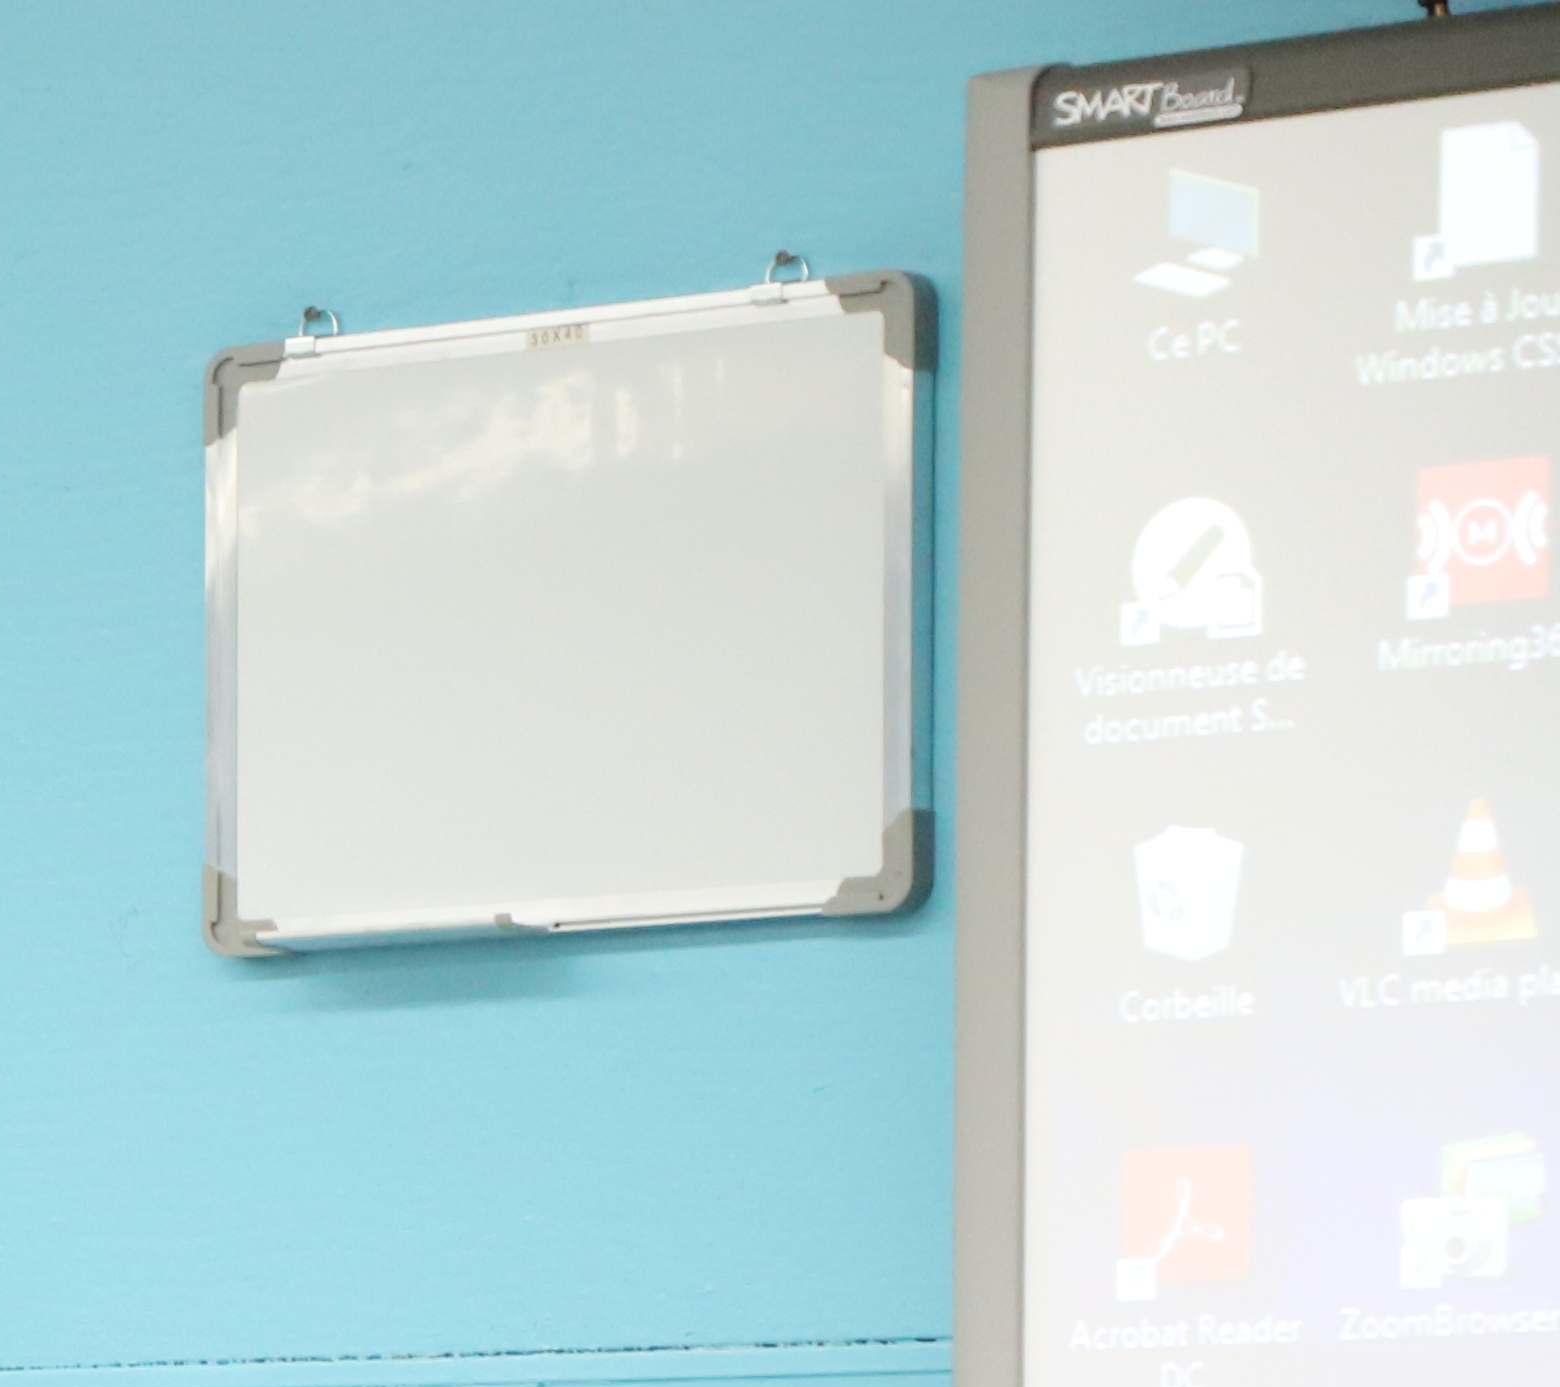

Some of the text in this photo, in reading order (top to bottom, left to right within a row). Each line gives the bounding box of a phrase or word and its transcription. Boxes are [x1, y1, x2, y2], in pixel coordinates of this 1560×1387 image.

[1053, 76, 1235, 127] SMART Board
[1395, 296, 1470, 335] Mise
[1480, 288, 1498, 325] à
[1147, 319, 1243, 362] Ce PC
[1355, 332, 1560, 387] Windows CS
[1074, 650, 1306, 699] Visionneuse de
[1084, 702, 1242, 746] document
[1120, 987, 1256, 1024] Corbeille
[1337, 973, 1401, 1010] VLC
[1410, 966, 1507, 1001] media
[1070, 1311, 1304, 1352] Acrobat Reader
